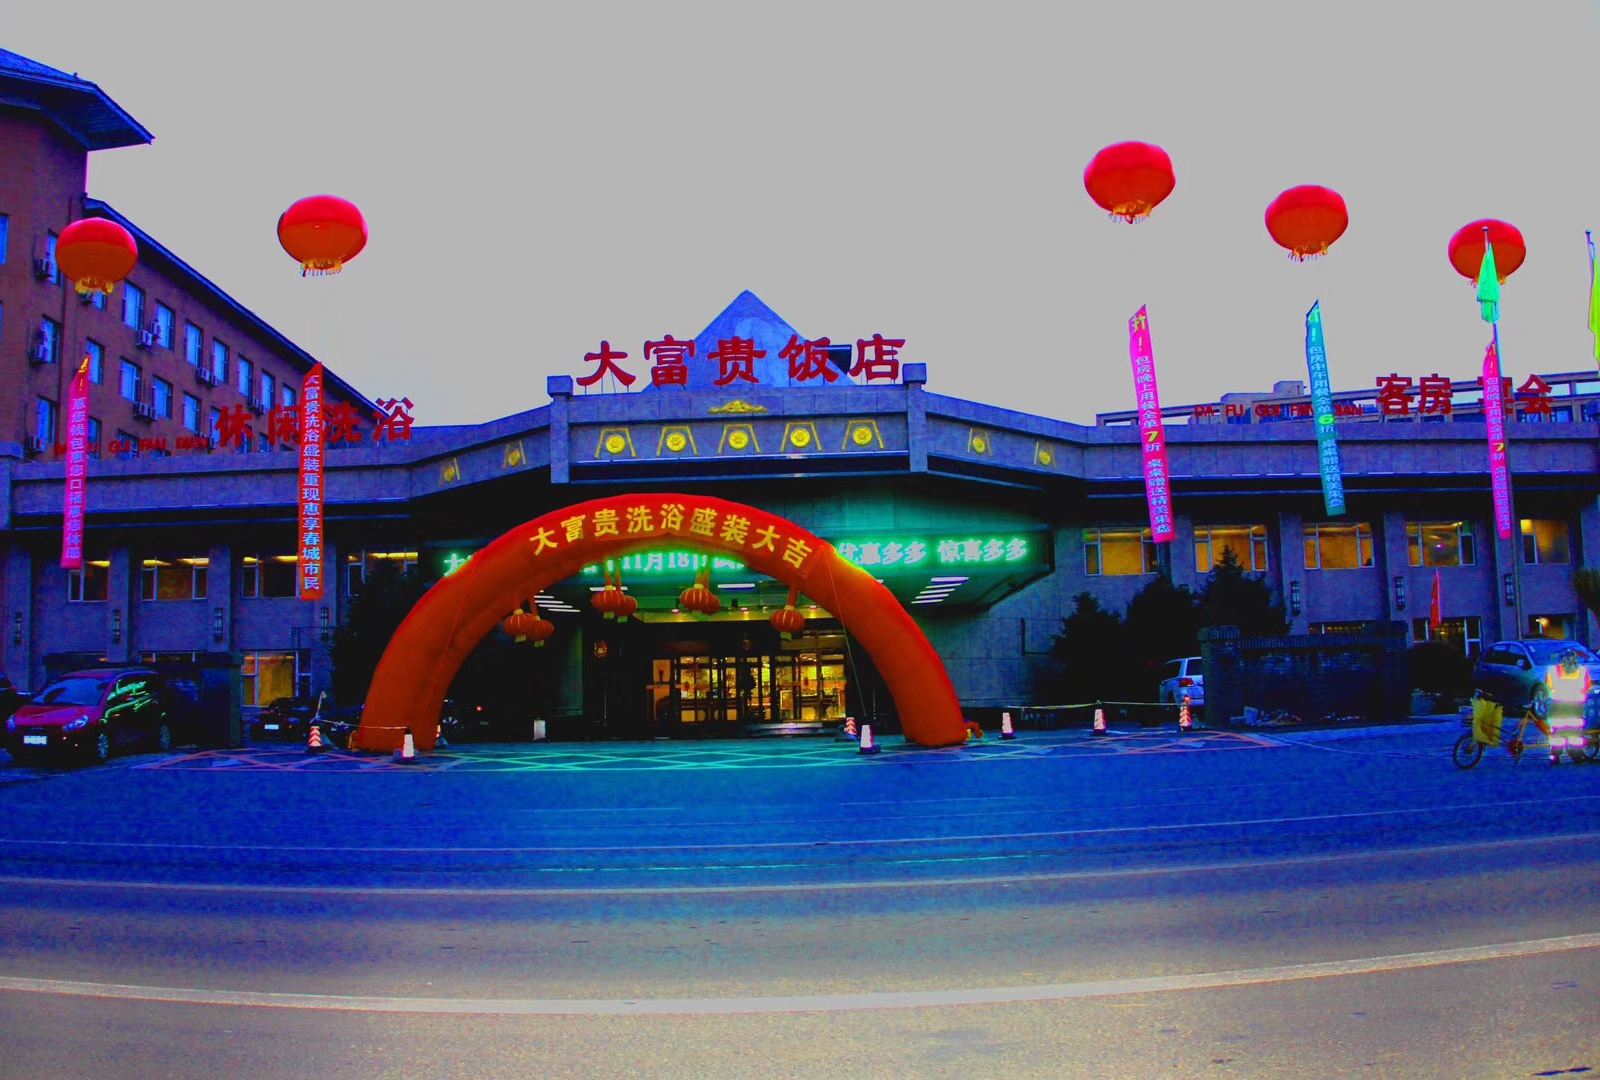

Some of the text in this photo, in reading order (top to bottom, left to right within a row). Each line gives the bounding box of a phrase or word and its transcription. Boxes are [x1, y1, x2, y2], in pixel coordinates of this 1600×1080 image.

[576, 333, 906, 386] 大富贵饭店
[1194, 404, 1214, 416] DA
[1226, 404, 1244, 416] FU
[303, 375, 321, 590] 大富贵洗浴盛装重现惠享春城市民
[529, 503, 812, 568] 大富贵洗浴盛装大吉
